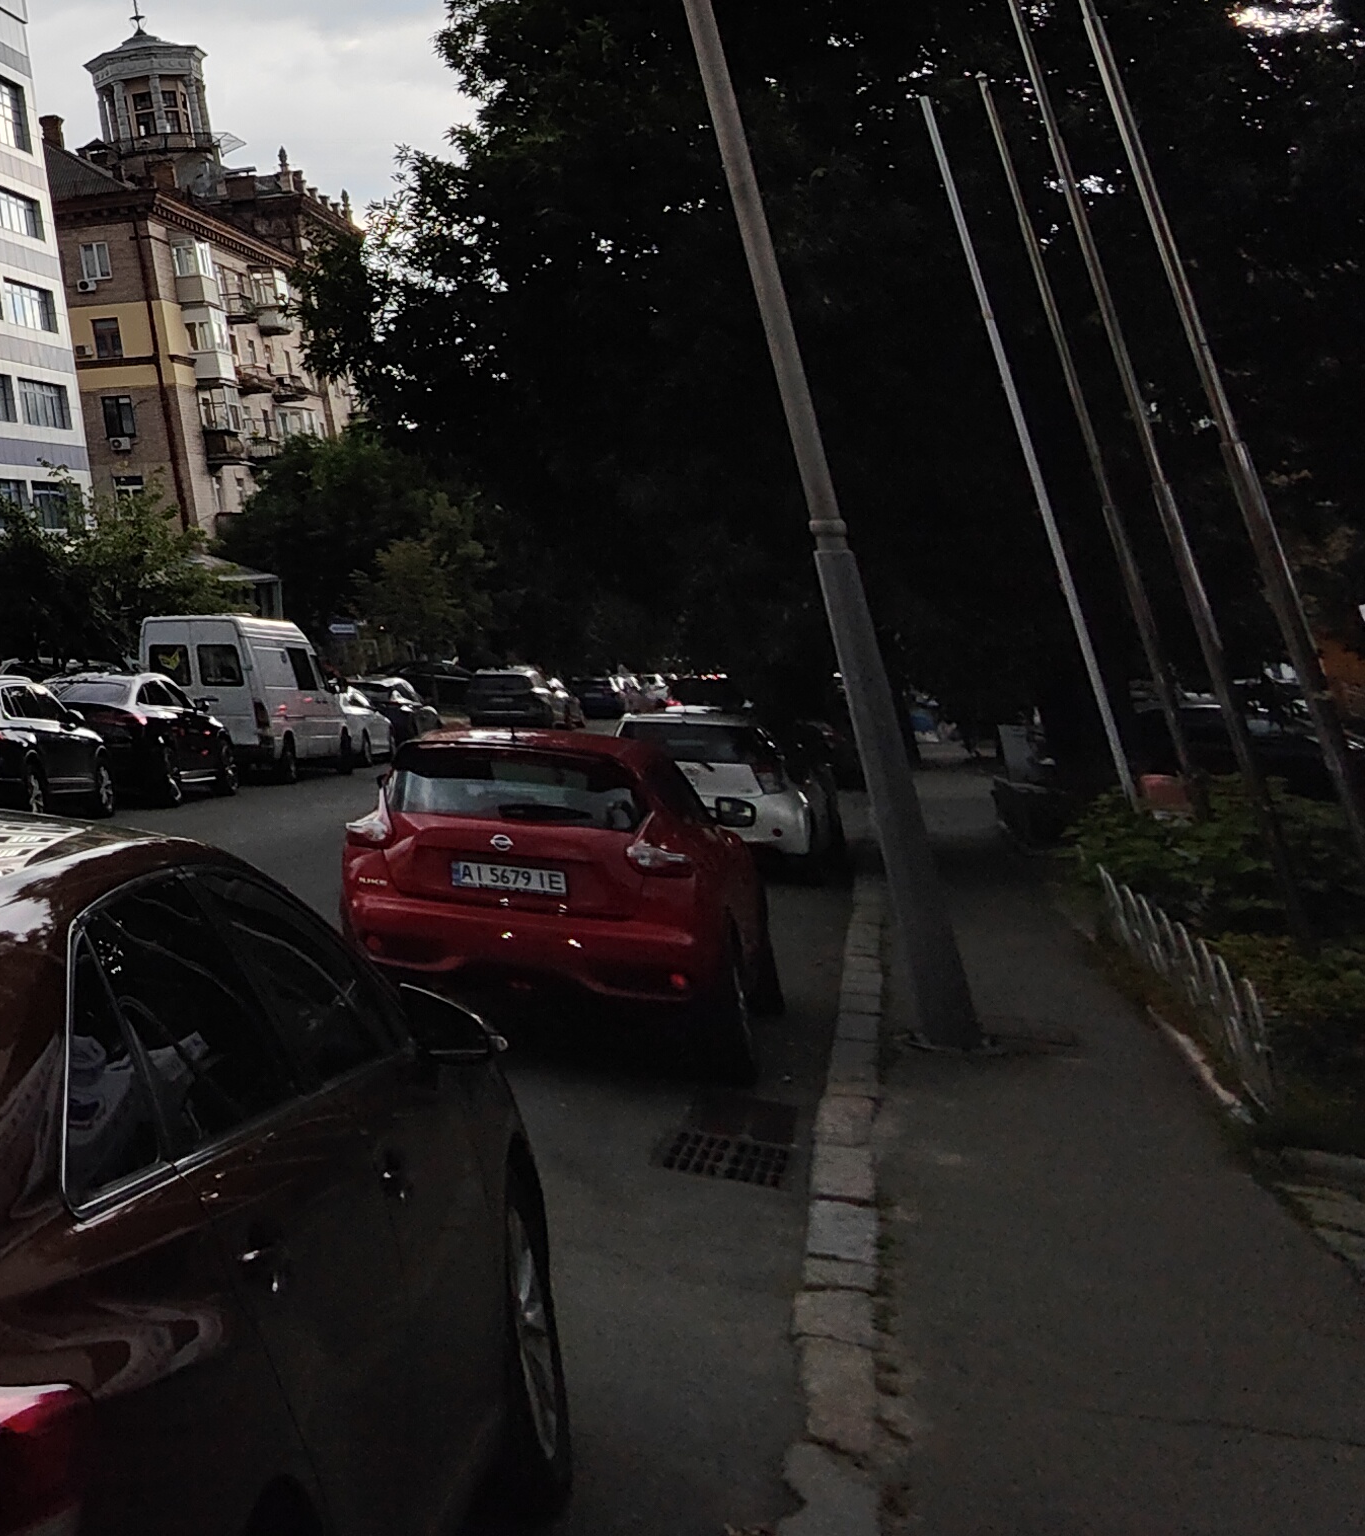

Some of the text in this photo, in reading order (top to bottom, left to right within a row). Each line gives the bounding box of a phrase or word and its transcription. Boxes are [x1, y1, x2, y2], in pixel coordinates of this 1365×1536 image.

[461, 865, 563, 891] AI 5679 IE
